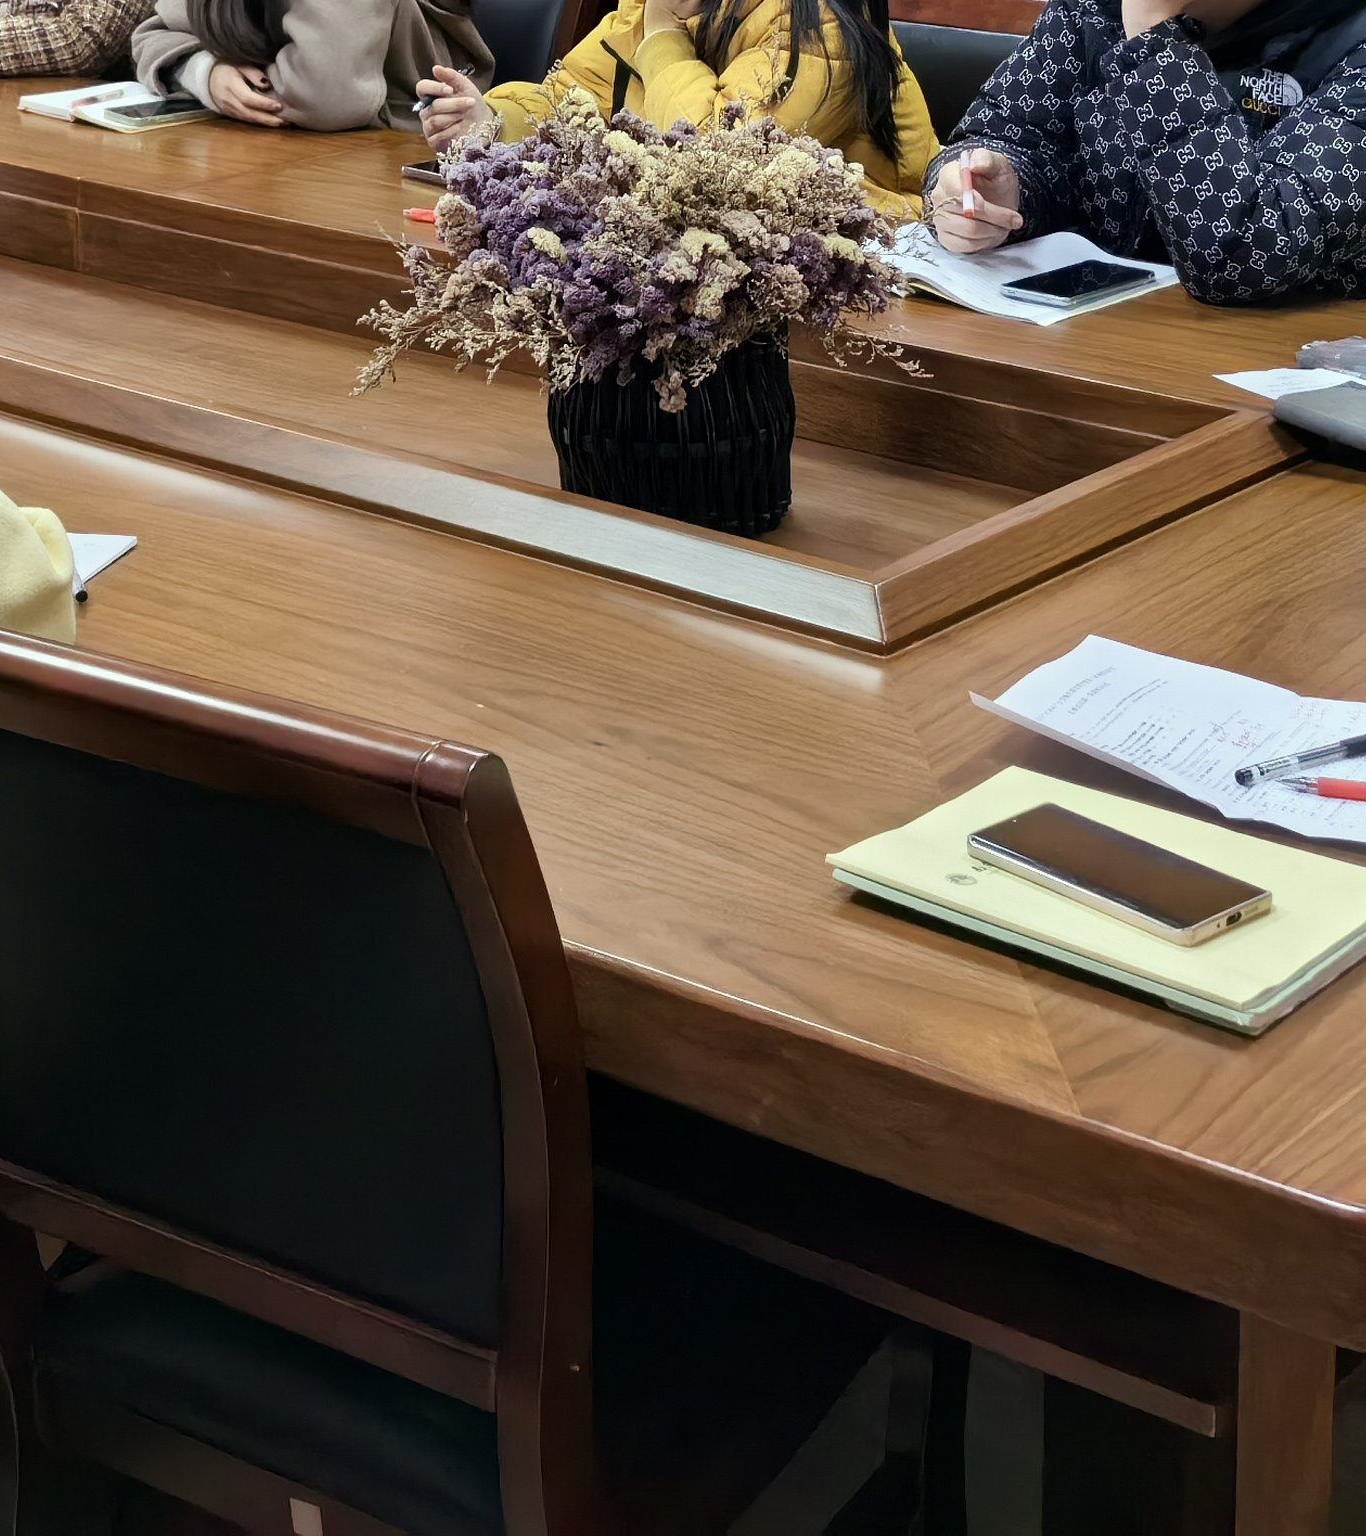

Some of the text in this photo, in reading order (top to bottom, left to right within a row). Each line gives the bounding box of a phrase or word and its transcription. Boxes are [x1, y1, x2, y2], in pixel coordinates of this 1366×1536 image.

[1262, 68, 1283, 84] THE
[1240, 75, 1282, 97] NORTH
[1252, 88, 1282, 105] FACE
[1242, 97, 1281, 116] GUCCI
